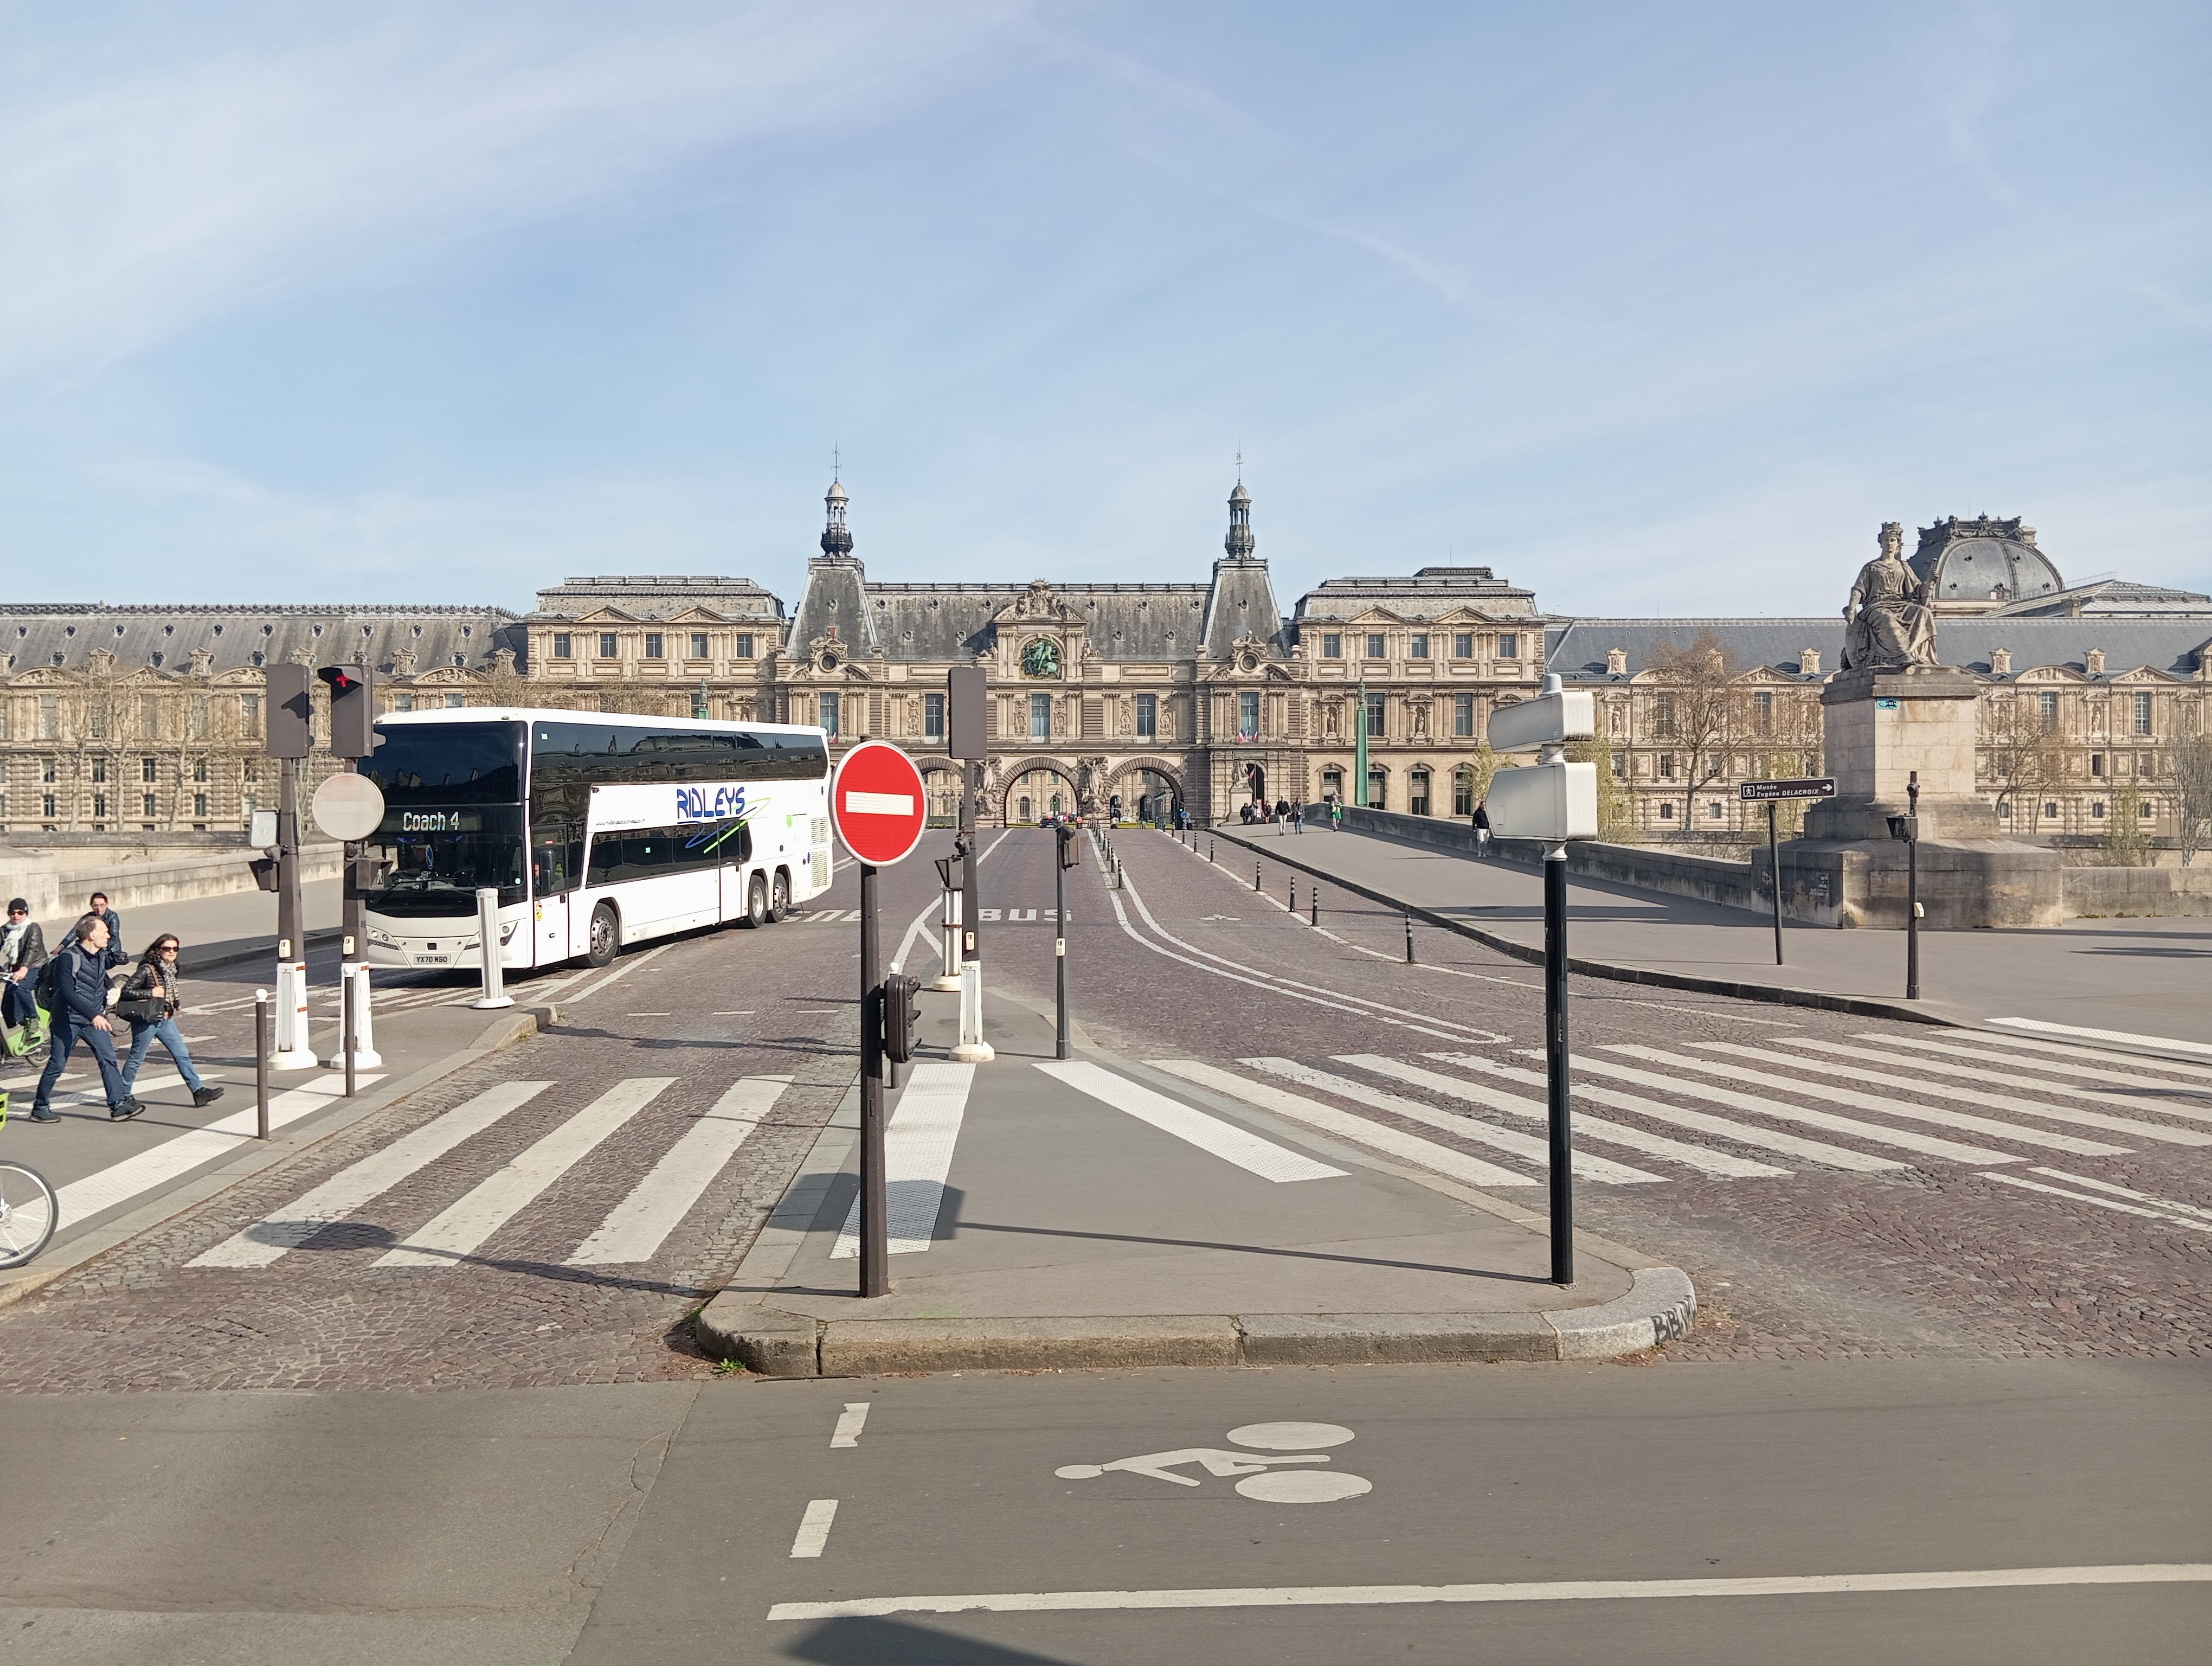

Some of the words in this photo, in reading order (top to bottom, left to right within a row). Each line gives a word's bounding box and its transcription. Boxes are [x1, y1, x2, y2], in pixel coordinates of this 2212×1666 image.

[677, 786, 745, 819] RIDLEYS
[403, 811, 446, 831] Coach
[450, 811, 460, 831] 4
[978, 908, 1072, 922] BUS
